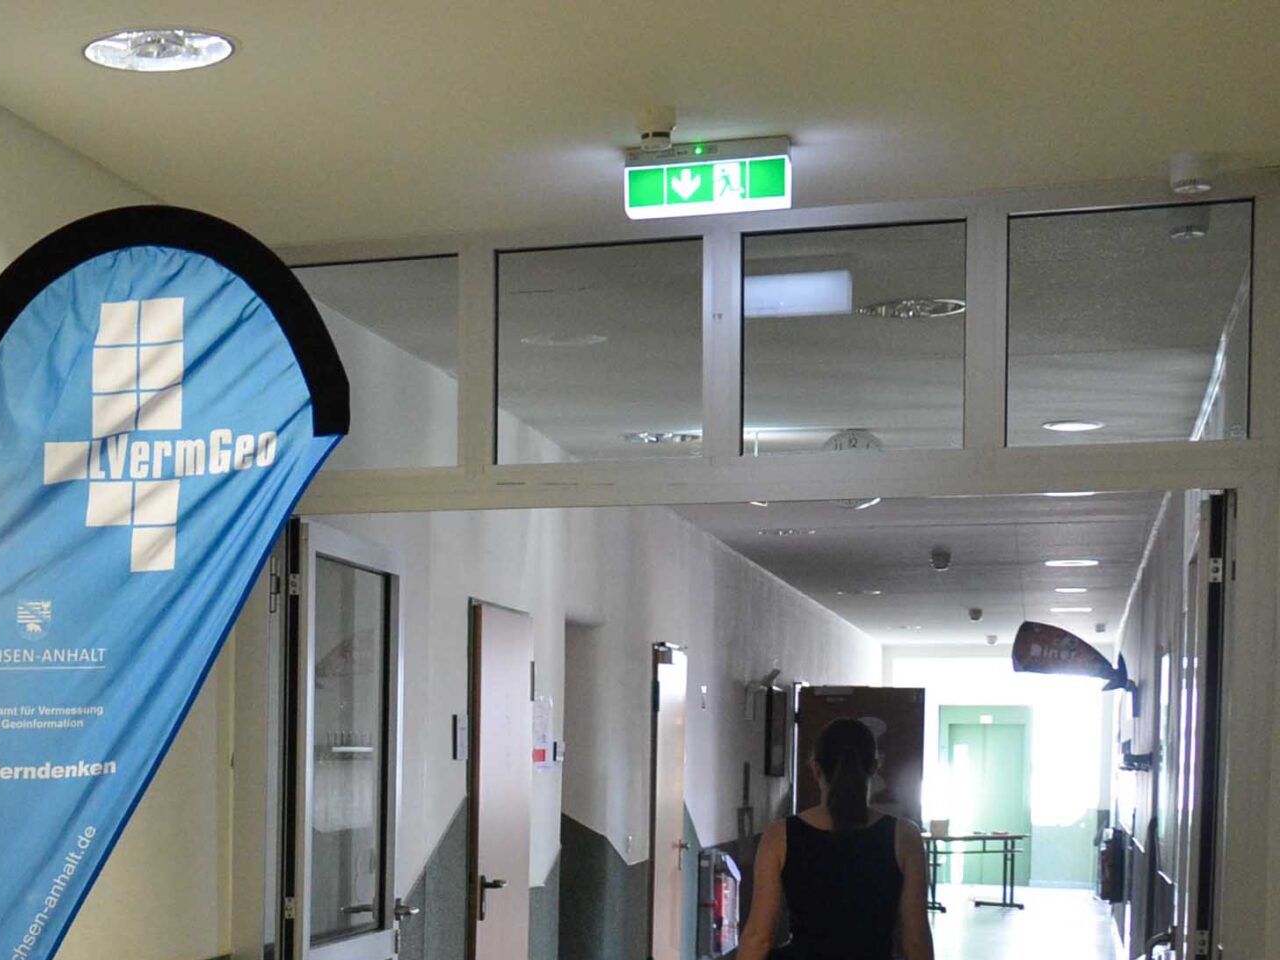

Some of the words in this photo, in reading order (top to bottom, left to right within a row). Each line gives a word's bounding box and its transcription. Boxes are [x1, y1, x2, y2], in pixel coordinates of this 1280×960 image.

[90, 428, 278, 480] LVermGeo
[20, 705, 35, 716] für
[38, 705, 104, 717] Vermessung
[1, 718, 84, 730] Geoinformation
